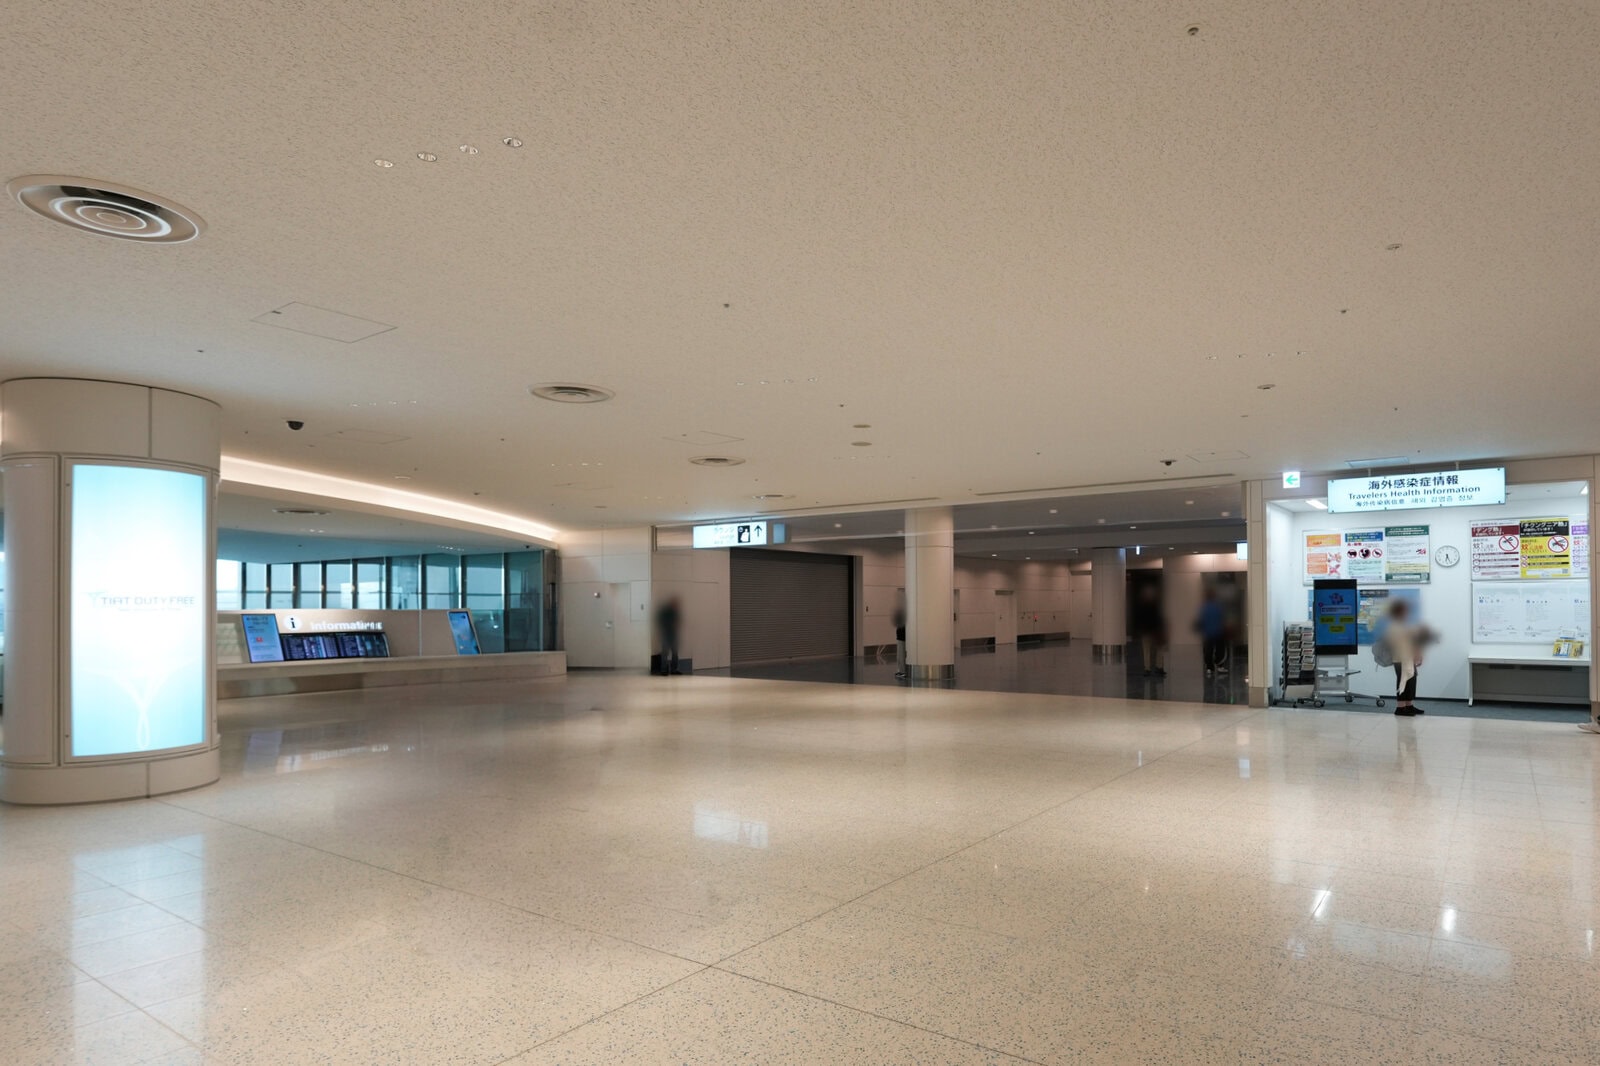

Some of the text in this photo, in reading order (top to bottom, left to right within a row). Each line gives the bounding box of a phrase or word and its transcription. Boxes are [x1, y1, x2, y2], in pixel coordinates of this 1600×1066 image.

[1368, 475, 1459, 490] 海外感染症情報
[1349, 485, 1481, 500] Travelers Health Information
